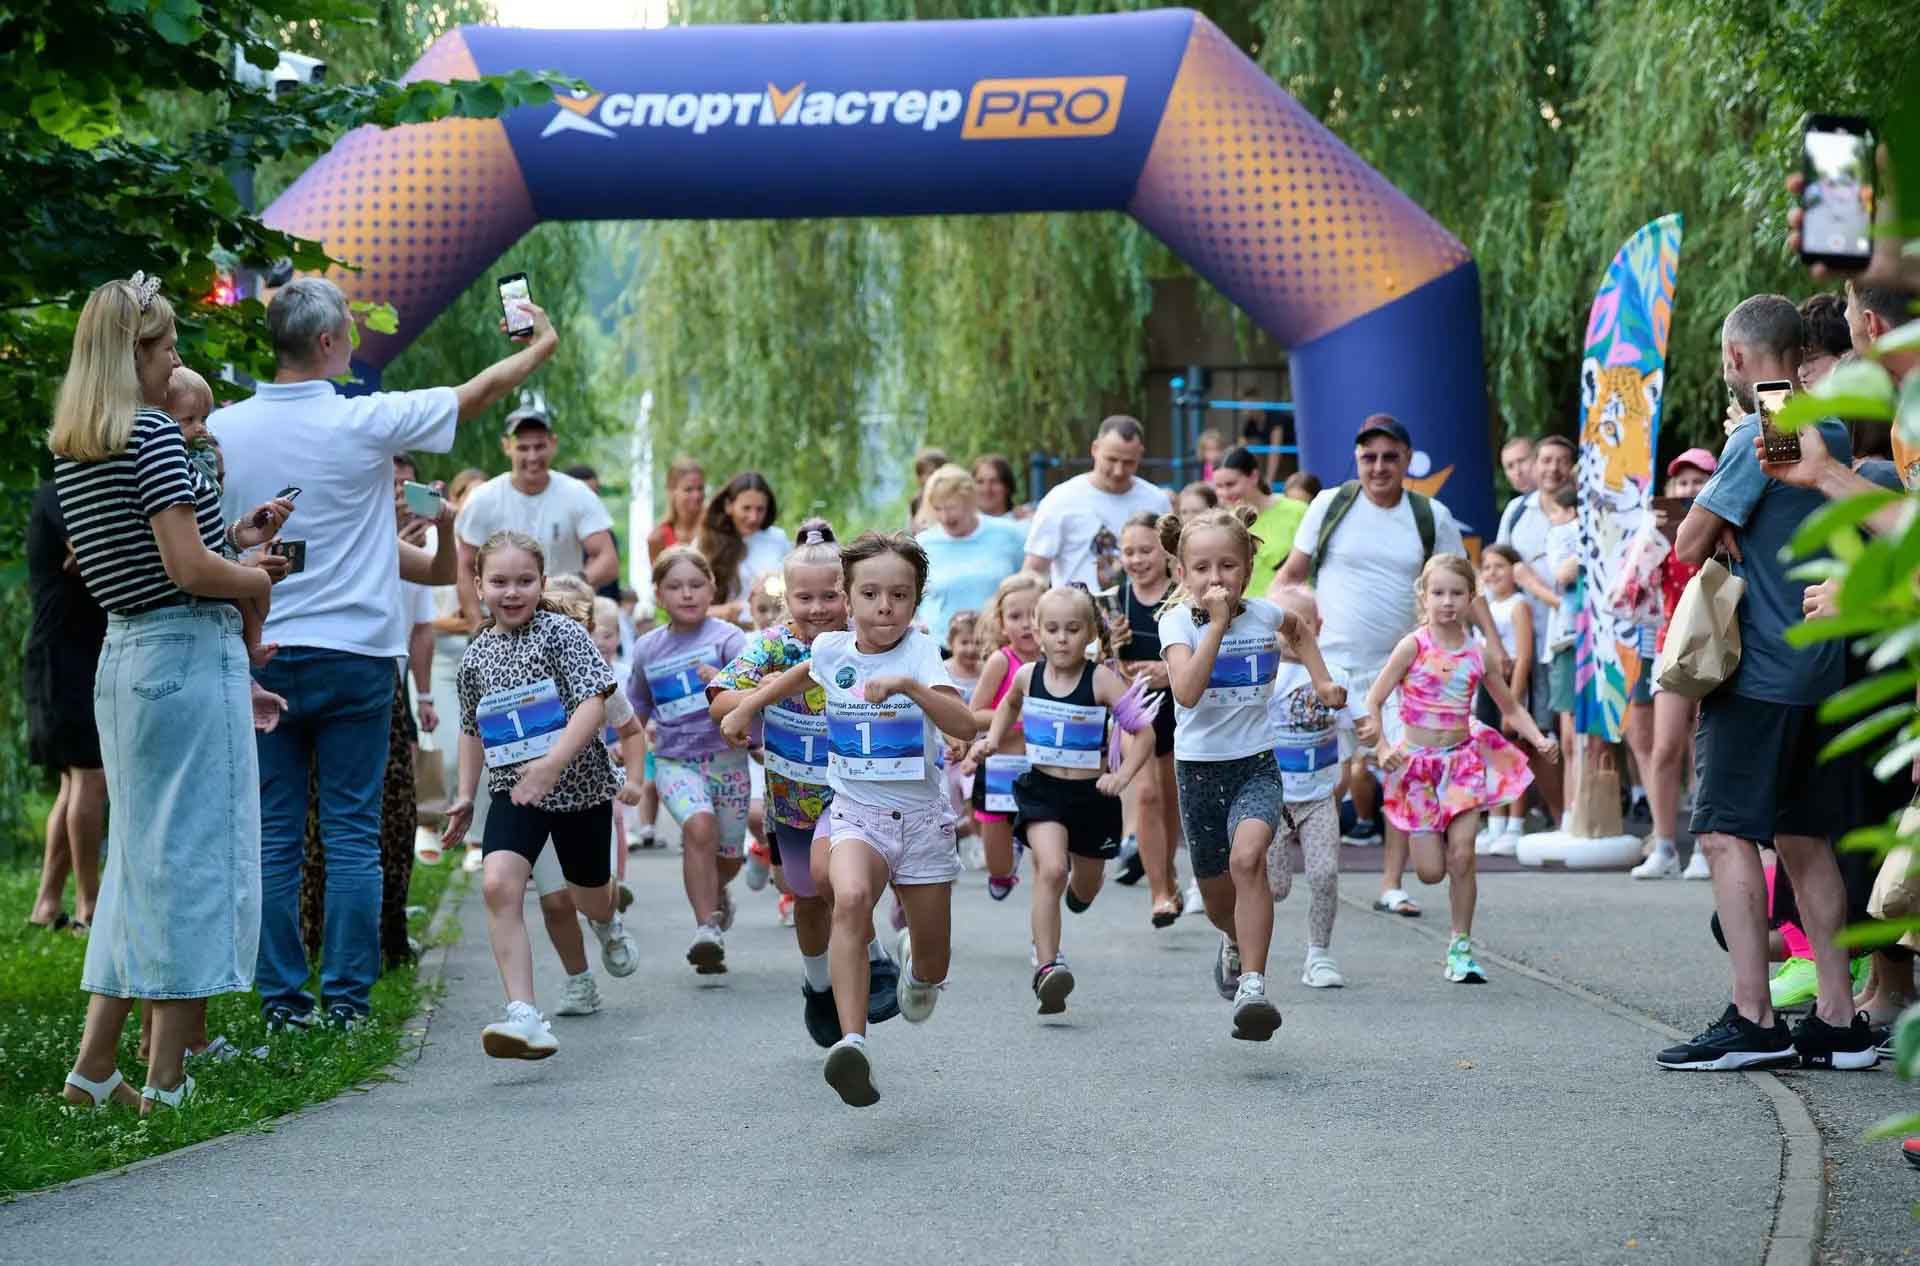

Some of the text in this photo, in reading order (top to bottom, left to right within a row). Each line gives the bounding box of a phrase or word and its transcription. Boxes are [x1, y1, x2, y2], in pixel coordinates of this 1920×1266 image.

[974, 88, 1109, 128] PRO
[1244, 654, 1258, 682] 1
[676, 671, 692, 695] 1
[506, 709, 525, 738] 1
[1053, 721, 1065, 746] 1
[800, 735, 814, 763] 1
[855, 721, 872, 755] 1
[1303, 748, 1315, 770] 1
